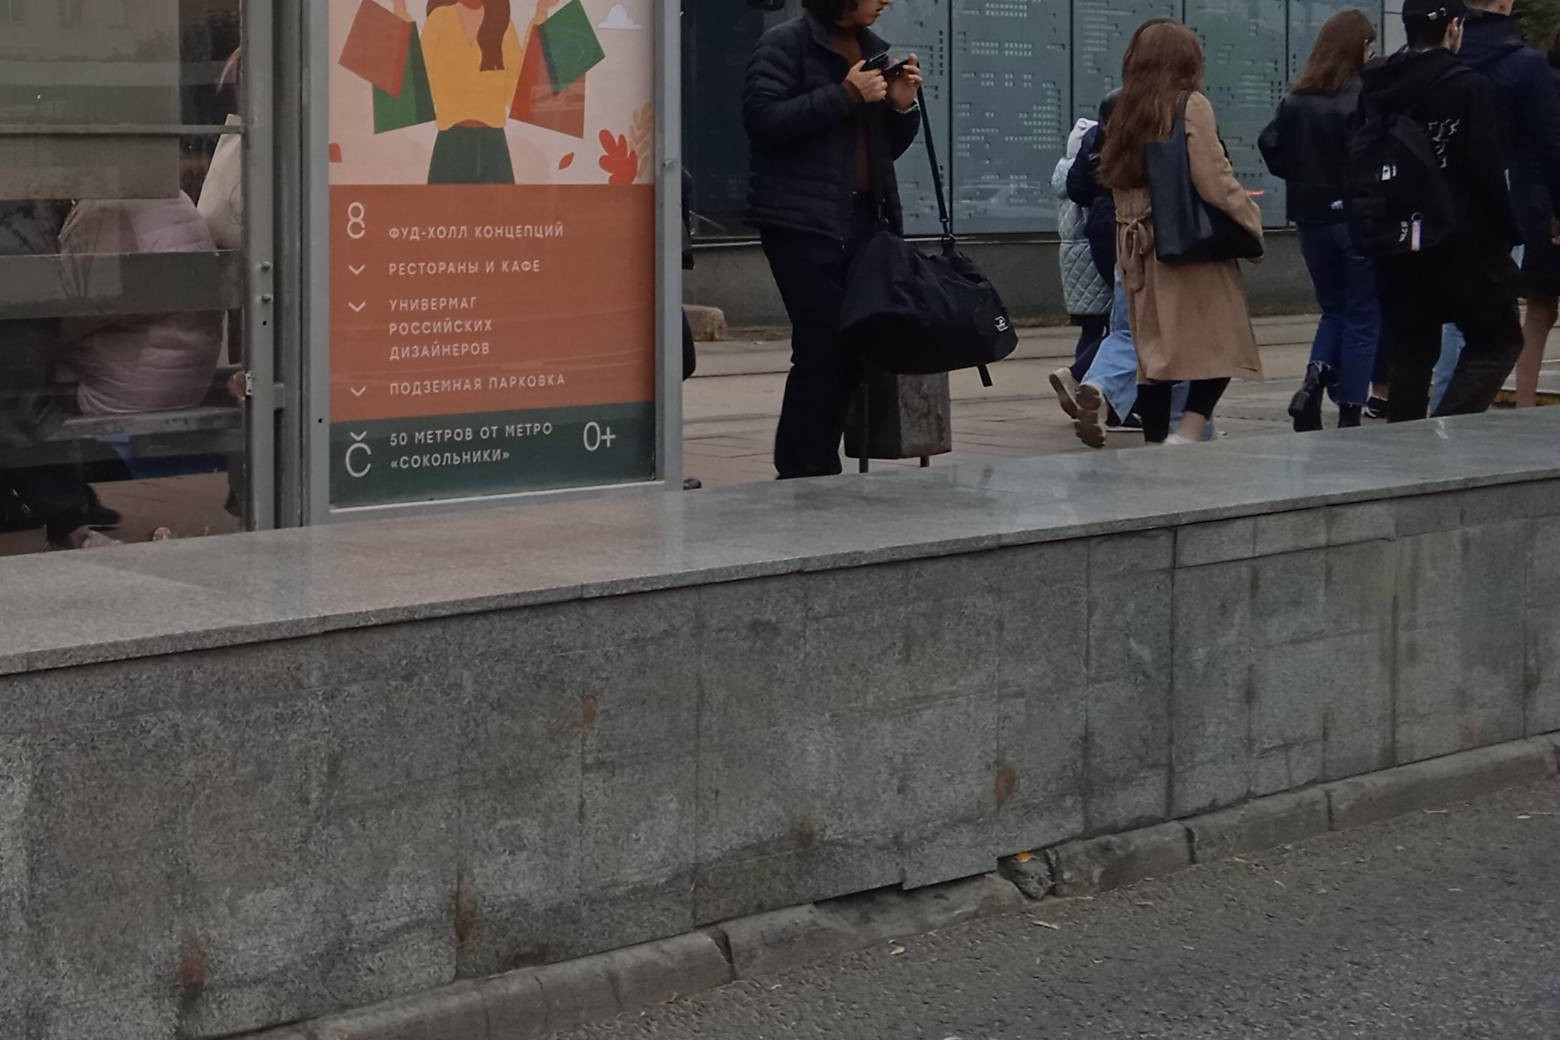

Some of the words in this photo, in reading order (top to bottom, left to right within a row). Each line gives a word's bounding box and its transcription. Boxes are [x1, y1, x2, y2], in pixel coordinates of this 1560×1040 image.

[389, 225, 468, 241] ФУД-ХОЛЛ
[474, 221, 564, 239] КОНЦЕПЦИЙ
[389, 261, 479, 276] РЕСТОРАНЫ
[486, 261, 495, 273] И
[502, 260, 540, 273] КАФЕ
[389, 296, 477, 311] УНИВЕРМАГ
[389, 318, 492, 335] РОССИЙСКИХ
[389, 341, 490, 360] ДИЗАЙНЕРОВ
[390, 378, 482, 395] ПОДЗЕМНАЯ
[489, 374, 566, 389] ПАРКОВКА
[390, 432, 407, 446] 50
[415, 427, 473, 445] МЕТРОВ
[480, 425, 498, 439] ОТ
[505, 422, 553, 437] МЕТРО
[583, 421, 616, 451] 0+
[390, 448, 510, 469] «СОКОЛЬНИКИ»
